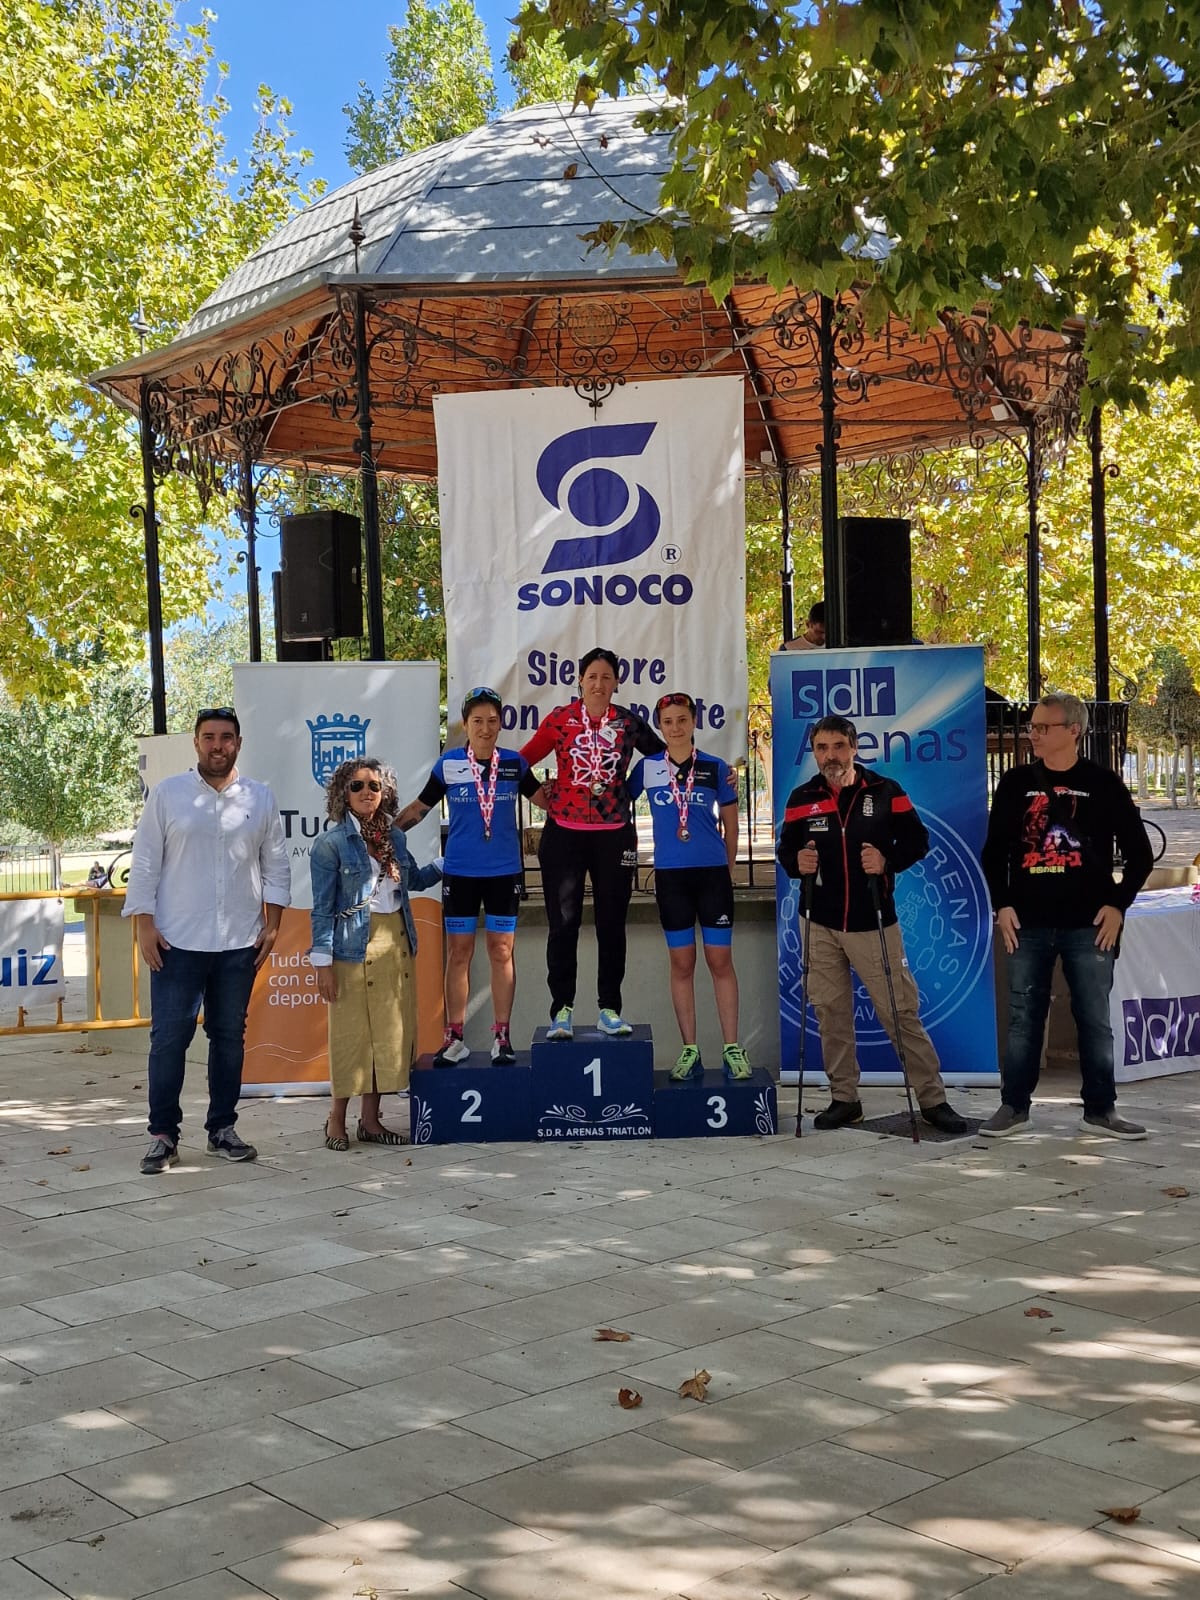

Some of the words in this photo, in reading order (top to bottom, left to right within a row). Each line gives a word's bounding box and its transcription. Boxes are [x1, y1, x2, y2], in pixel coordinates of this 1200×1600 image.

[517, 573, 693, 611] SONOCO
[798, 670, 887, 717] sdr
[794, 722, 968, 766] Aenas
[269, 975, 300, 987] con
[304, 971, 318, 986] el
[1126, 1001, 1200, 1060] sdr
[583, 1057, 602, 1097] 1
[460, 1089, 483, 1122] 2
[706, 1095, 729, 1129] 3
[537, 1128, 565, 1137] S.D.R.
[566, 1127, 604, 1137] ARENAS
[606, 1126, 652, 1136] TRIATLON
